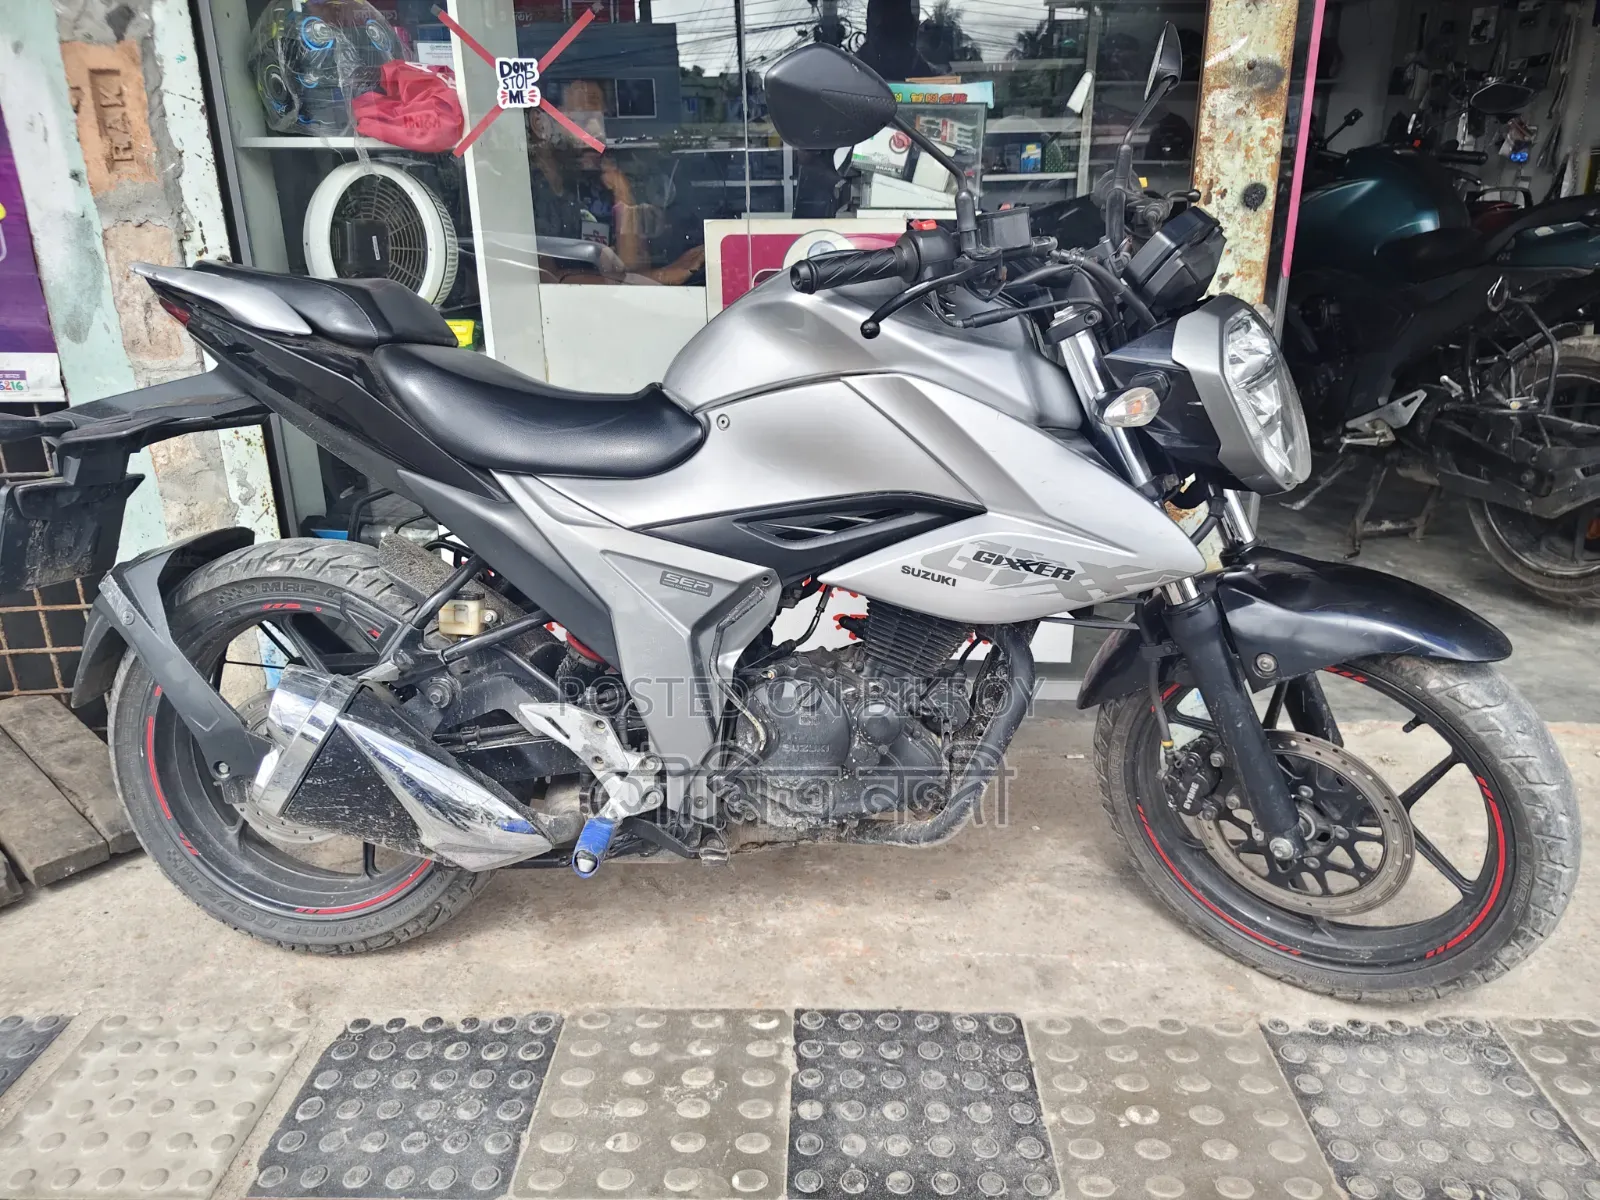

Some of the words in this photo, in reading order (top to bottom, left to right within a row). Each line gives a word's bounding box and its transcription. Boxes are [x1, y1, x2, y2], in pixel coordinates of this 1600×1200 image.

[503, 70, 536, 89] STOP
[509, 90, 528, 104] ME
[972, 549, 1076, 581] GIXXER
[663, 573, 710, 589] SEP
[901, 565, 957, 587] SUZUKI
[261, 581, 316, 593] MRF
[782, 744, 830, 753] SUZUKI
[1183, 782, 1200, 810] BYBRE
